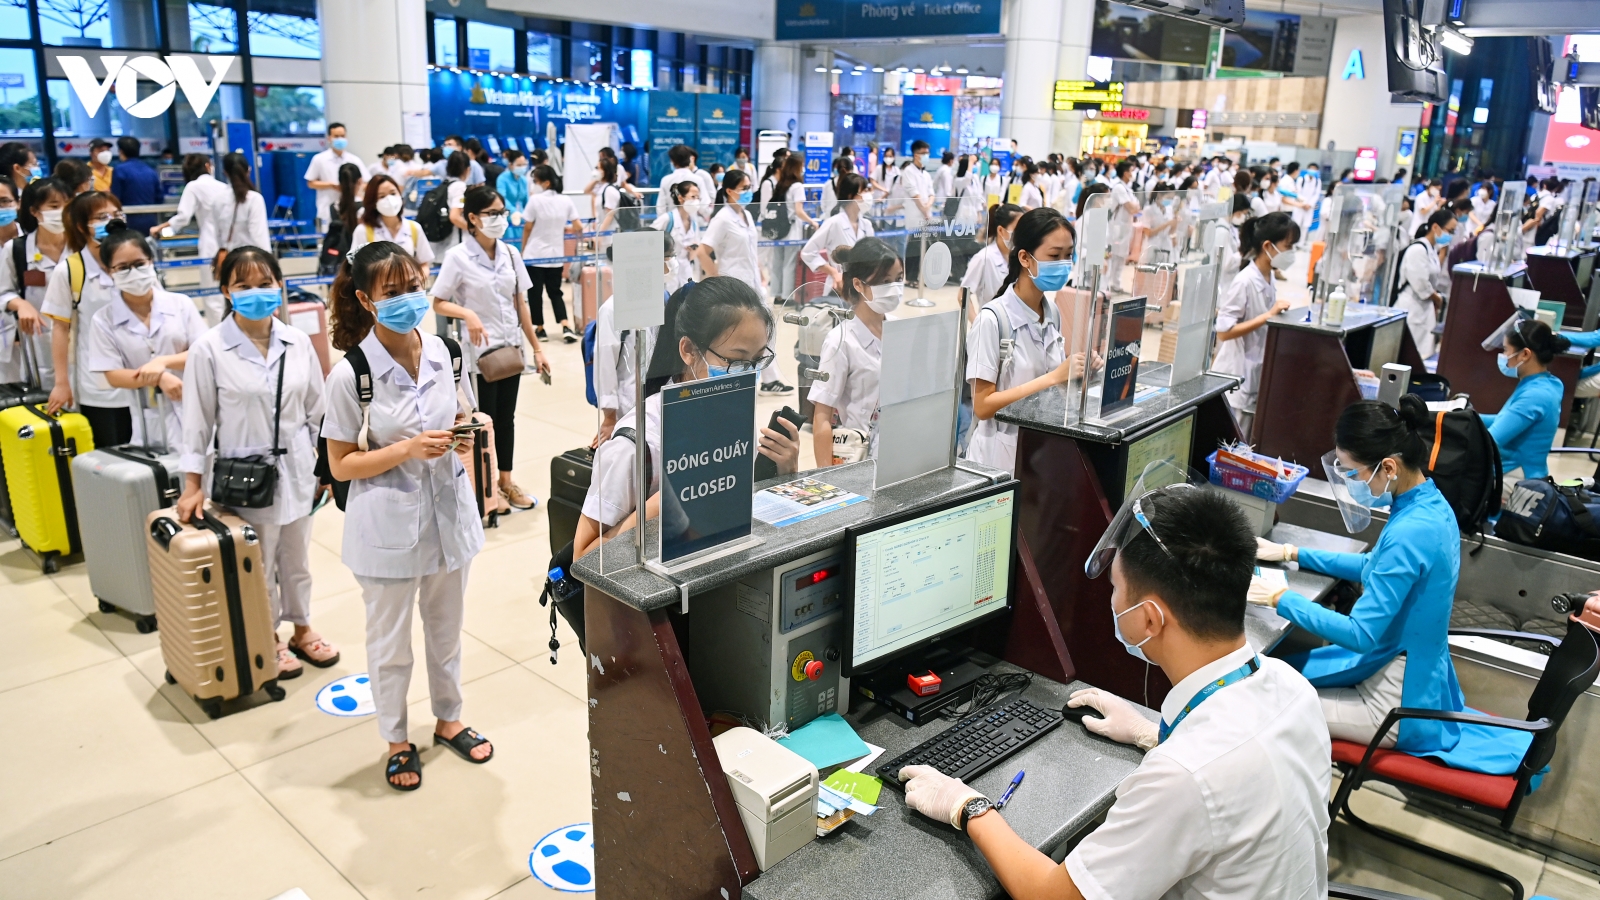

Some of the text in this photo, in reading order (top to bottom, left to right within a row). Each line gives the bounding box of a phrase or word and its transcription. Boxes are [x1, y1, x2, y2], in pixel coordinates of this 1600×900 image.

[924, 2, 982, 16] Ticket Office
[1341, 49, 1365, 81] A
[807, 158, 821, 173] 40
[1110, 364, 1132, 379] CLOSED
[666, 450, 709, 475] ĐÓNG
[680, 474, 737, 502] CLOSED
